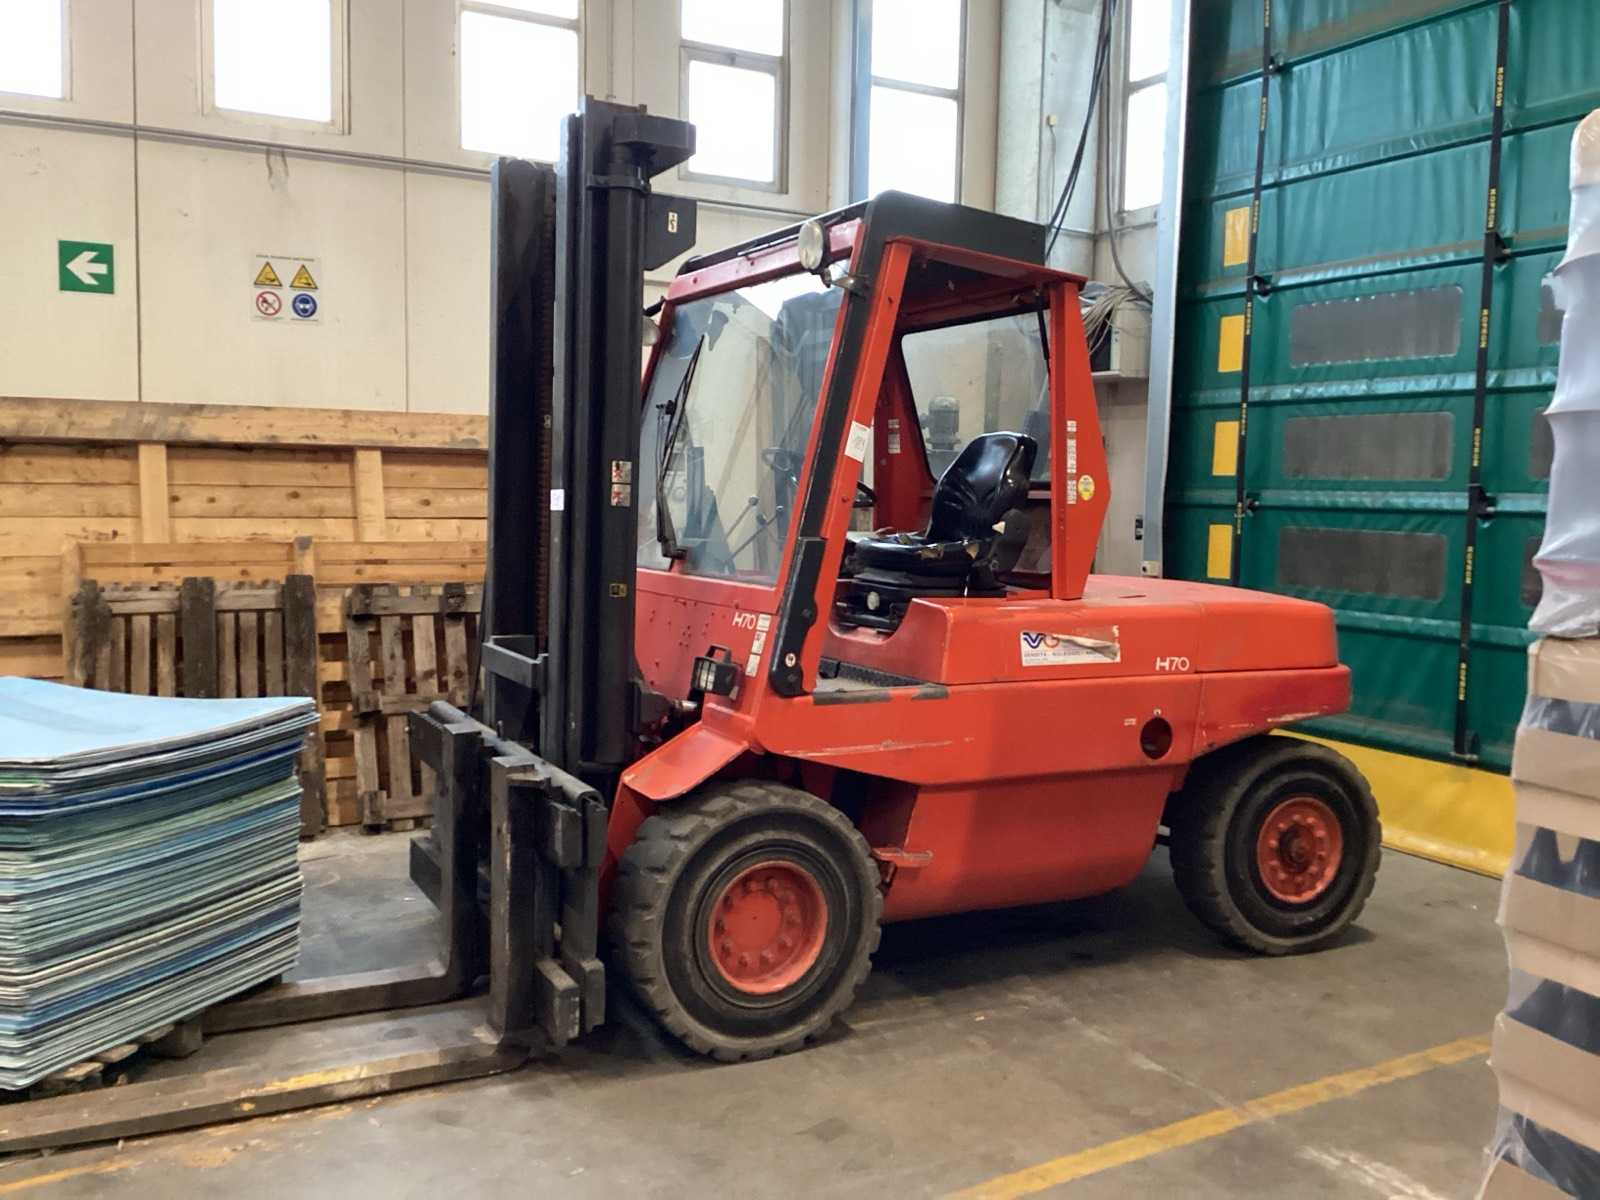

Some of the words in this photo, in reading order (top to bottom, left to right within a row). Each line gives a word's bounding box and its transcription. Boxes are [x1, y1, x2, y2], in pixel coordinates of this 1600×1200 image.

[1496, 67, 1504, 107] KOPRON
[1488, 188, 1497, 228] KOPRON
[1480, 309, 1489, 348] KOPRON
[732, 612, 756, 630] H70
[1156, 656, 1190, 671] H70
